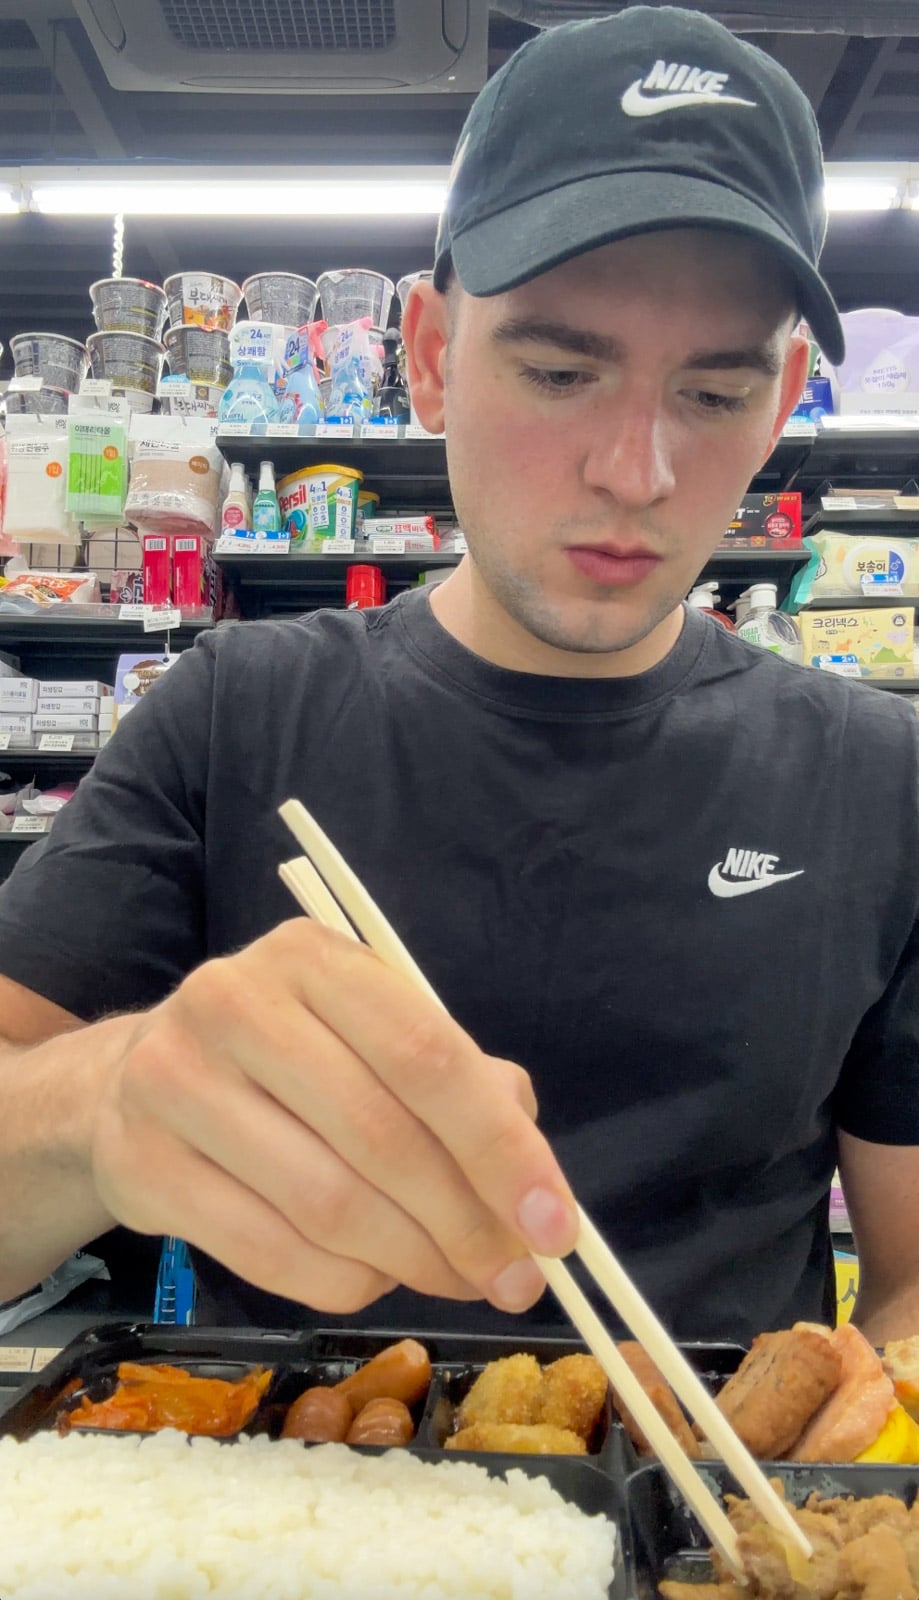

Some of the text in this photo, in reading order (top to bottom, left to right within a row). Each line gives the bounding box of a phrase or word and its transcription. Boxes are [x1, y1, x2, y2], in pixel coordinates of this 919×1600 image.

[642, 60, 729, 95] NIKE
[250, 329, 263, 339] 24
[237, 346, 266, 357] 상쾌함
[856, 560, 887, 573] 보송이
[812, 617, 859, 629] 크리넥스
[721, 848, 780, 879] NIKE
